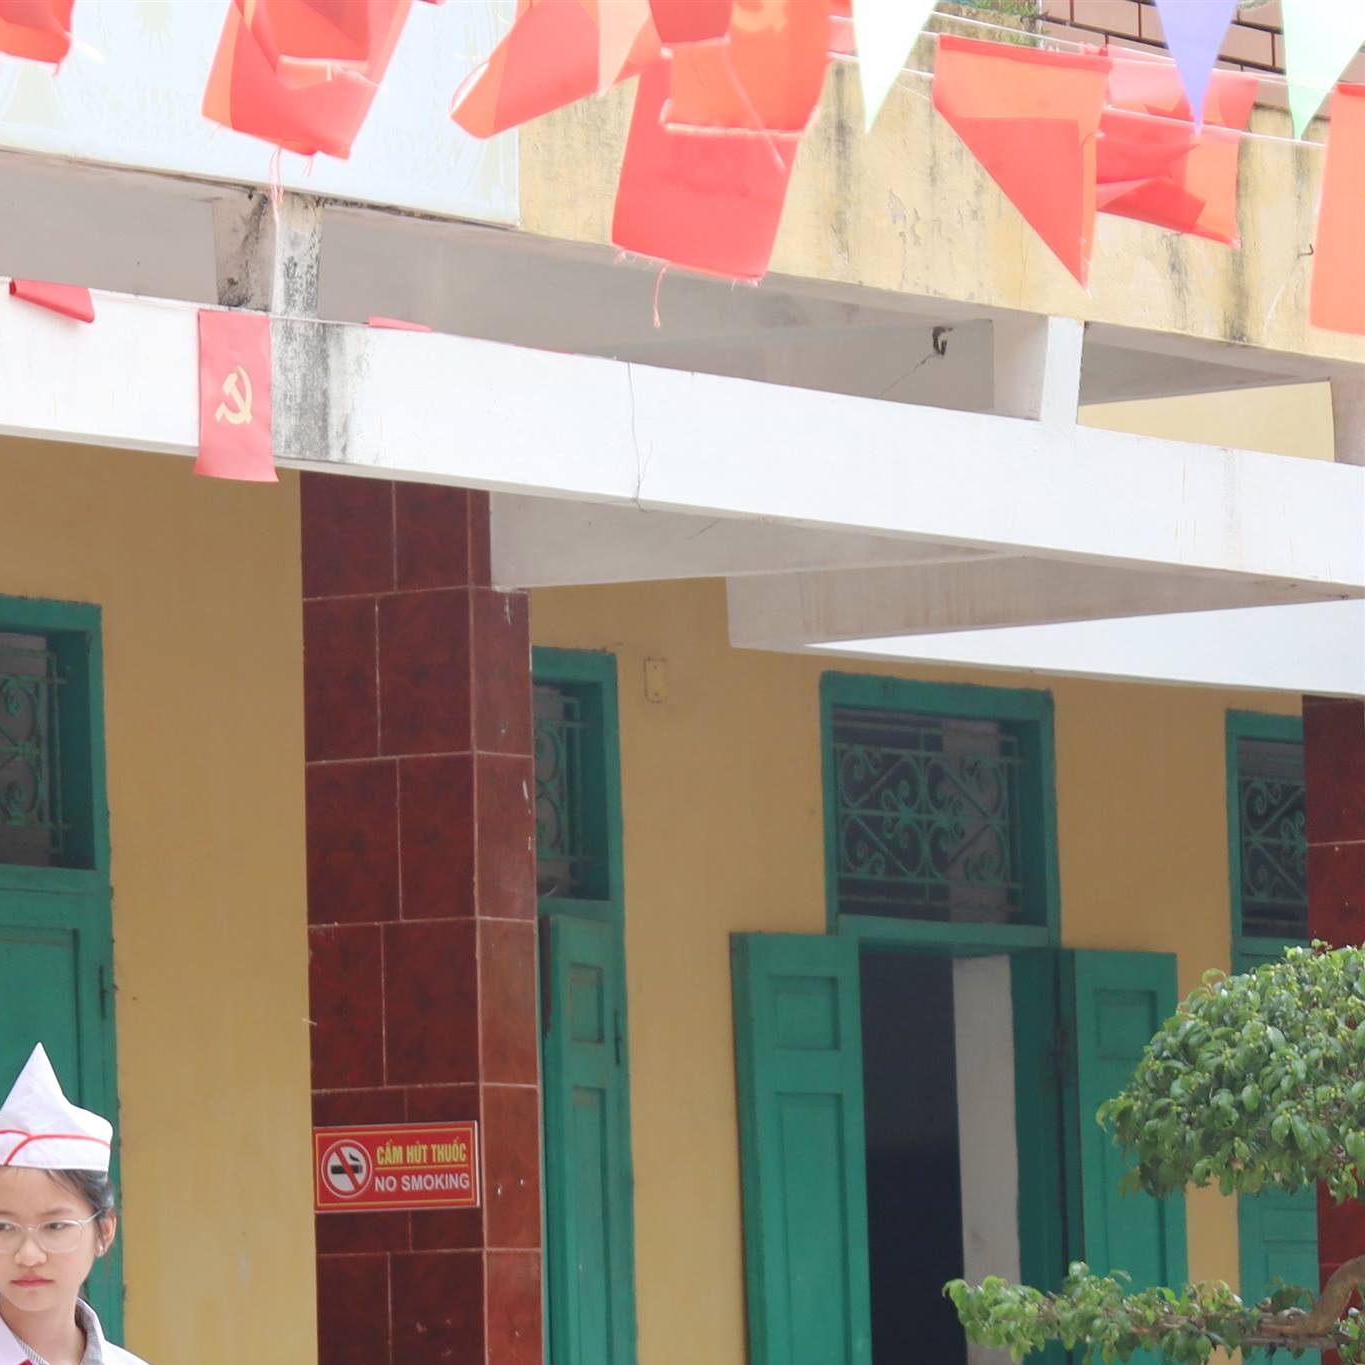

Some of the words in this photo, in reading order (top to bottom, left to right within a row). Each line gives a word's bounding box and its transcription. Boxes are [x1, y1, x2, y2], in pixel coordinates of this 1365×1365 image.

[376, 1138, 404, 1166] CẤM
[406, 1140, 429, 1164] HÚT
[431, 1135, 467, 1163] THUỐC
[374, 1175, 397, 1192] NO
[400, 1172, 470, 1192] SMOKING
